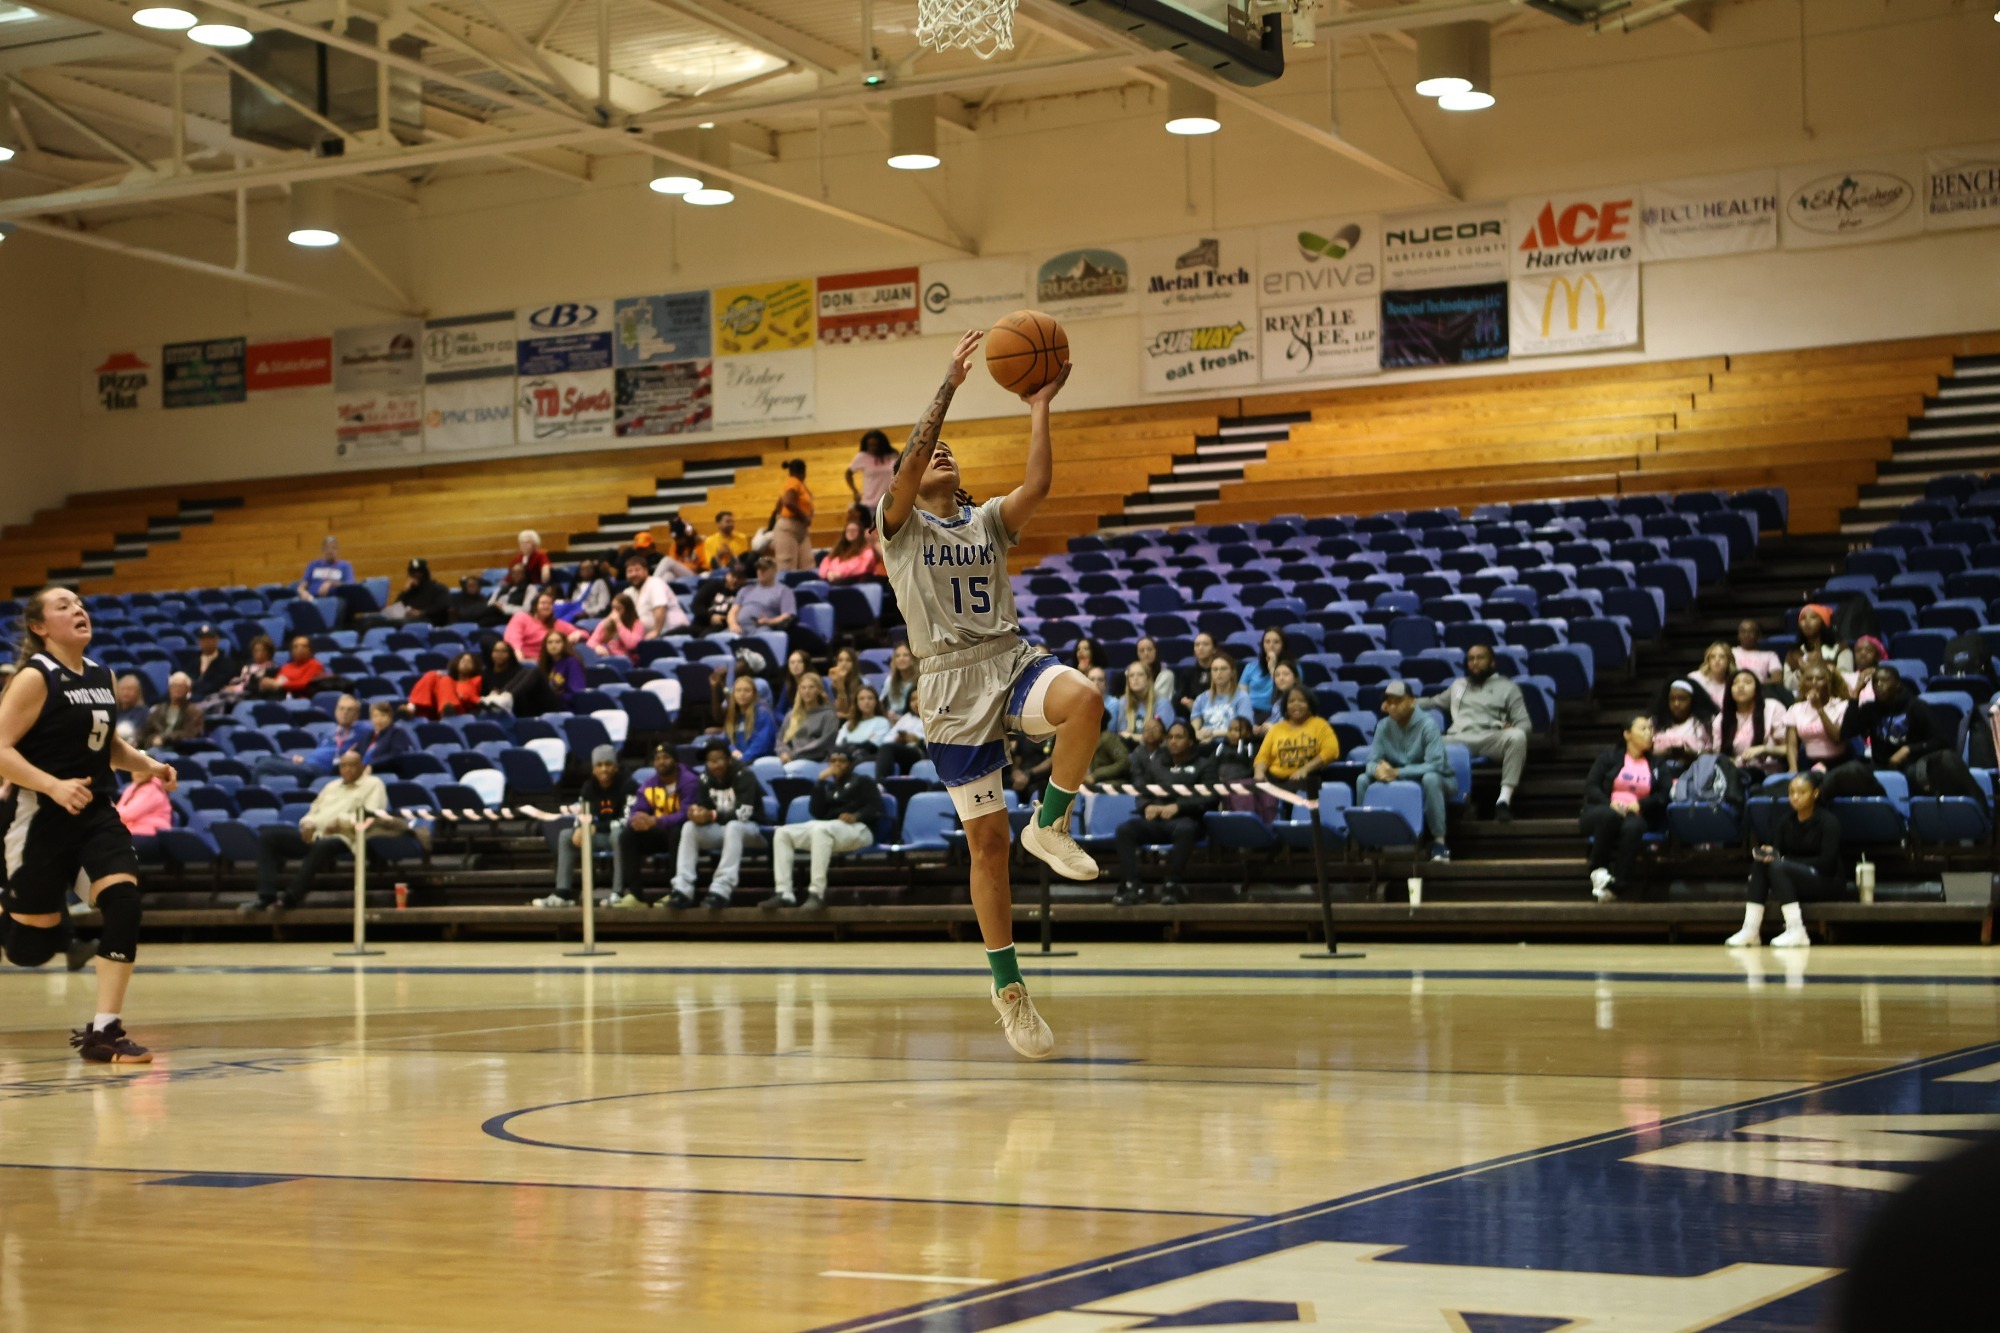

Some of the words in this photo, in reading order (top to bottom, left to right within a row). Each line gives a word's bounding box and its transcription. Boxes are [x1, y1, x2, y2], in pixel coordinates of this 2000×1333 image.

[1661, 203, 1698, 223] ECU
[1703, 195, 1776, 218] HEALTH
[1810, 189, 1834, 210] El
[1386, 221, 1501, 247] NUCOR
[1519, 198, 1633, 250] ACE
[1387, 248, 1450, 263] HERTFORD
[1458, 243, 1507, 256] COUNTY
[1526, 245, 1631, 269] Hardware
[1037, 273, 1128, 298] RUGGED
[1148, 271, 1199, 294] Metal
[1203, 266, 1249, 288] Tech
[1264, 262, 1374, 295] enviva
[821, 293, 853, 309] DON
[872, 286, 912, 304] JUAN
[1265, 306, 1356, 333] REVELLE
[456, 341, 496, 356] REALTY
[1147, 321, 1246, 358] SUBWAY
[1354, 330, 1376, 343] LLP
[728, 366, 786, 388] Parker
[1166, 361, 1194, 381] eat
[1200, 349, 1255, 372] fresh.
[98, 371, 148, 393] Pizza
[101, 391, 138, 411] Hut
[562, 387, 612, 422] Sports
[742, 388, 807, 416] Agency
[442, 409, 468, 425] PNC
[474, 406, 511, 424] BANK
[950, 576, 991, 615] 15
[87, 709, 110, 751] 5
